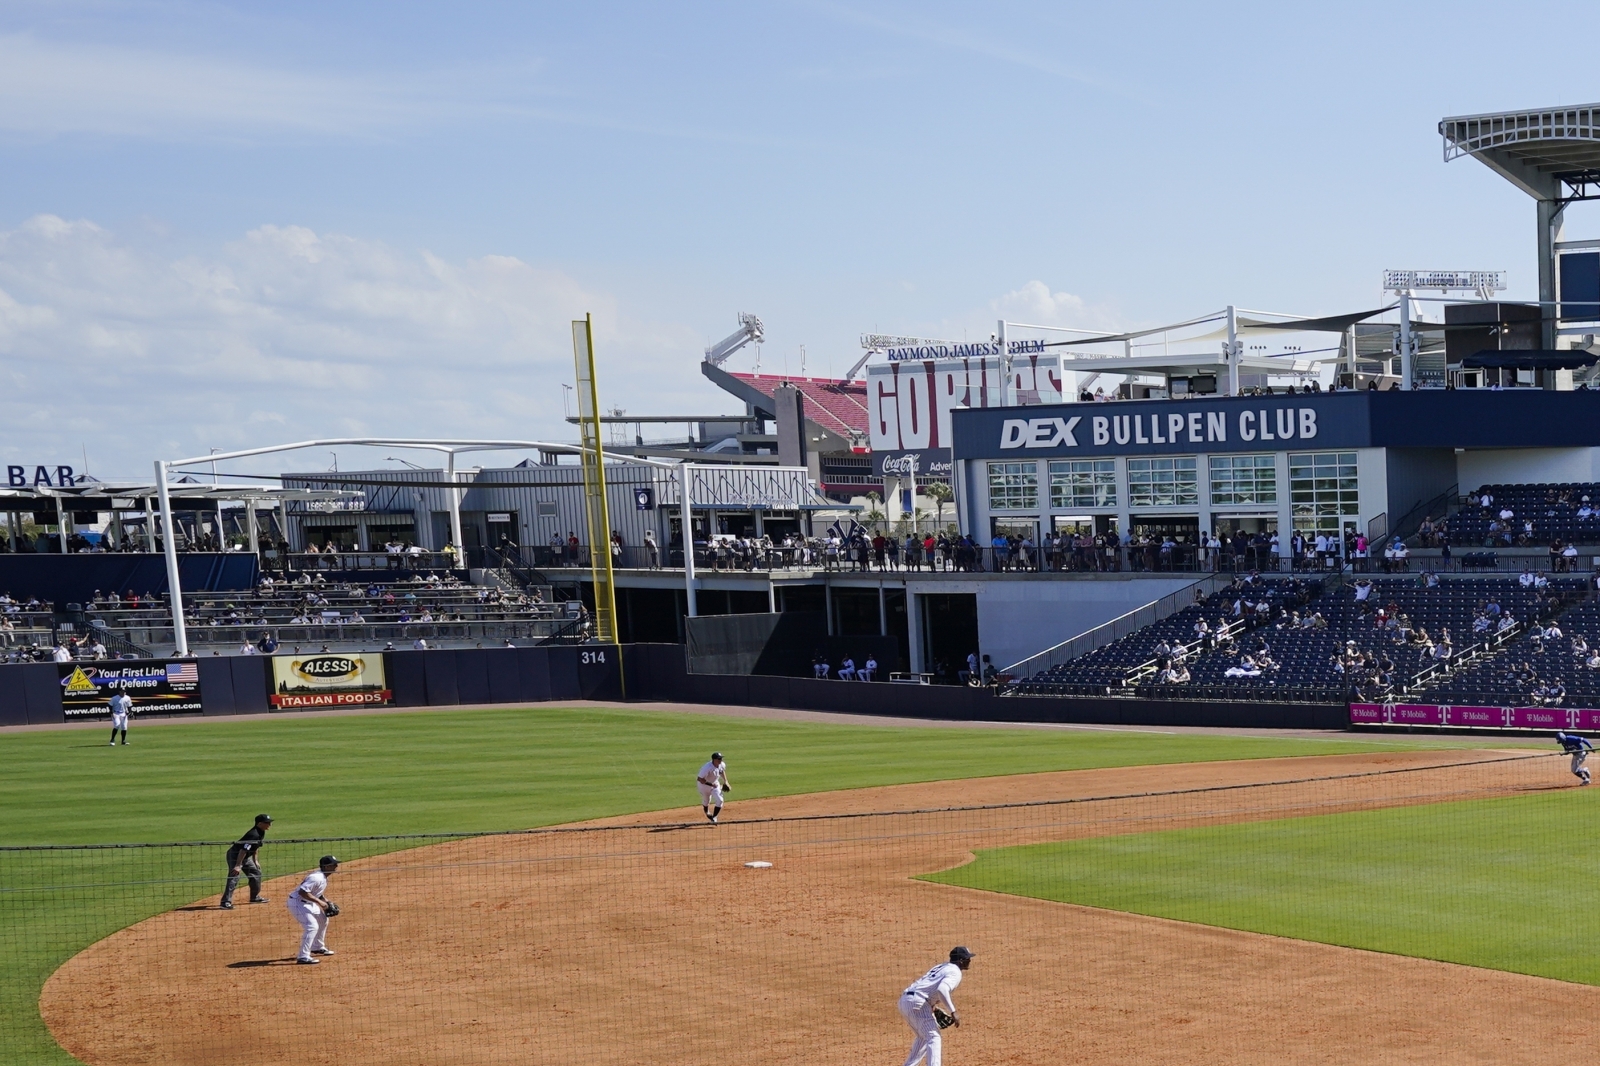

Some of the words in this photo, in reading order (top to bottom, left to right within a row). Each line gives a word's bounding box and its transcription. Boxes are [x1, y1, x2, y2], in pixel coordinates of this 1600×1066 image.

[888, 346, 948, 360] RAYMOND
[950, 342, 989, 357] JAMES
[992, 339, 1045, 355] SADIUM
[1000, 416, 1082, 449] DEX
[1093, 411, 1227, 446] BULLPEN
[1239, 408, 1317, 441] CLUB
[7, 465, 75, 487] BAR
[581, 651, 605, 664] 314
[98, 668, 120, 679] Your
[122, 667, 143, 678] First
[145, 666, 165, 677] Line
[304, 660, 352, 673] ALESSI
[108, 679, 119, 689] of
[121, 678, 158, 688] Defense
[282, 695, 333, 706] ITALIAN
[337, 693, 382, 703] FOODS
